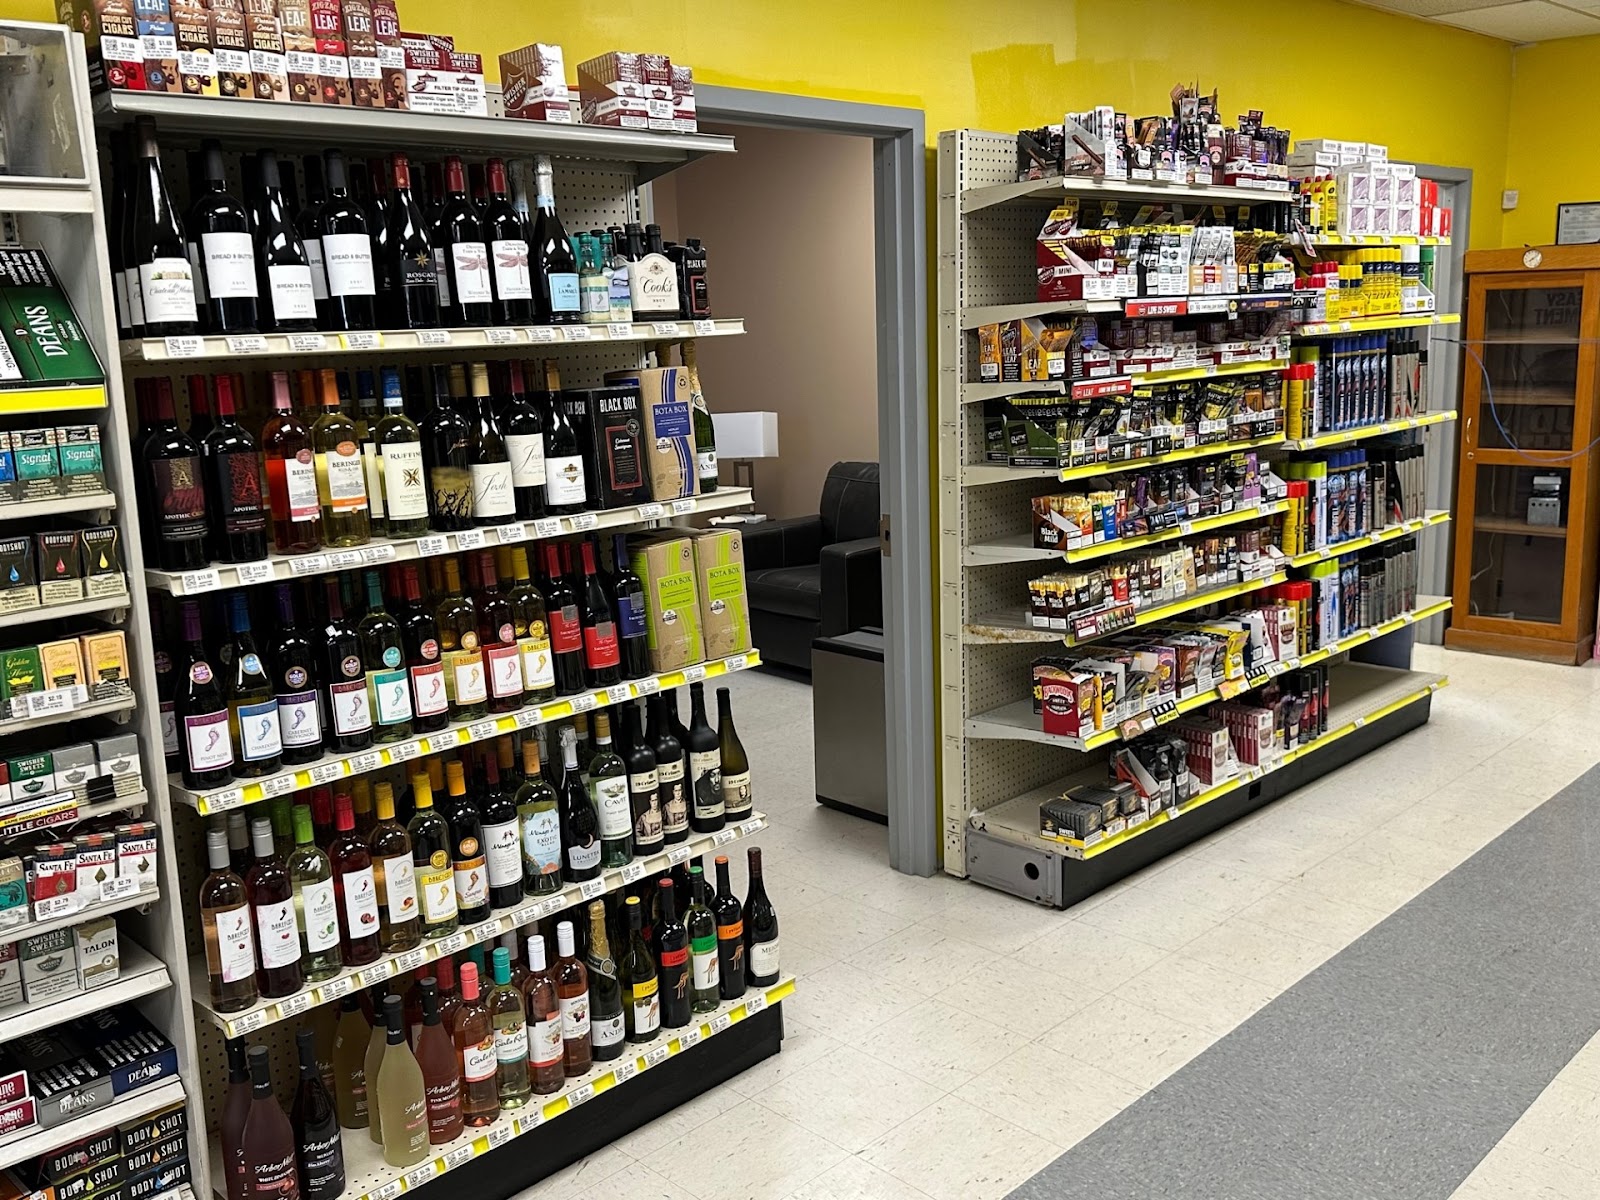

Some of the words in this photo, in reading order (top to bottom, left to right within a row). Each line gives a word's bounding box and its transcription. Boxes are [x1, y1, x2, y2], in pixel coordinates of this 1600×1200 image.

[101, 15, 119, 24] ROUGH
[281, 11, 308, 26] LEAF
[314, 14, 338, 31] LEAF
[347, 15, 372, 33] LEAF
[102, 23, 134, 35] CIGARS
[376, 19, 398, 37] LEAF
[180, 31, 209, 44] CIGARS
[216, 34, 245, 48] CIGARS
[253, 39, 281, 51] CIGARS
[409, 49, 440, 59] SWISHER
[449, 52, 478, 62] SWISHER
[411, 57, 440, 65] SWEETS
[451, 60, 478, 69] SWEETS
[1059, 267, 1072, 275] MINI
[643, 279, 673, 294] Cook's
[24, 305, 69, 357] DEANS
[1025, 358, 1042, 369] LEAF
[575, 401, 586, 415] BOX
[599, 398, 623, 413] BLACK
[623, 396, 638, 410] BOX
[654, 407, 672, 416] BOTA
[673, 405, 688, 414] BOX
[21, 452, 52, 465] Signal
[66, 449, 95, 461] Signal
[177, 471, 190, 486] A
[241, 472, 258, 496] A
[85, 530, 113, 540] BODYSHOT
[1040, 527, 1058, 536] Black
[45, 535, 74, 544] BODYSHOT
[1044, 535, 1058, 543] Mild
[709, 570, 726, 579] BOTA
[727, 566, 741, 576] BOX
[660, 580, 677, 589] BOTA
[678, 576, 692, 586] BOX
[1043, 685, 1075, 704] BACKWOODS
[17, 757, 45, 768] SWISHER
[20, 763, 45, 773] SWEETS
[604, 796, 627, 809] CAVIT
[4, 817, 19, 825] SAME
[19, 812, 43, 821] PRODUCT
[36, 810, 76, 827] CIGARS
[537, 836, 558, 845] EXOTIC
[573, 851, 600, 861] LUNETTA
[27, 930, 67, 947] SWISHER
[30, 938, 66, 953] SWEETS
[83, 939, 115, 954] TALON
[128, 1063, 162, 1084] DEANS
[127, 1126, 151, 1146] BODY
[159, 1113, 183, 1131] SHOT
[303, 1139, 330, 1154] Arbor
[55, 1152, 80, 1172] BOD
[89, 1137, 113, 1157] SHOT
[128, 1151, 152, 1171] BODY
[161, 1138, 184, 1157] SHOT
[255, 1160, 282, 1175] Arbor
[94, 1164, 119, 1185] SHOT
[131, 1177, 155, 1197] BODY
